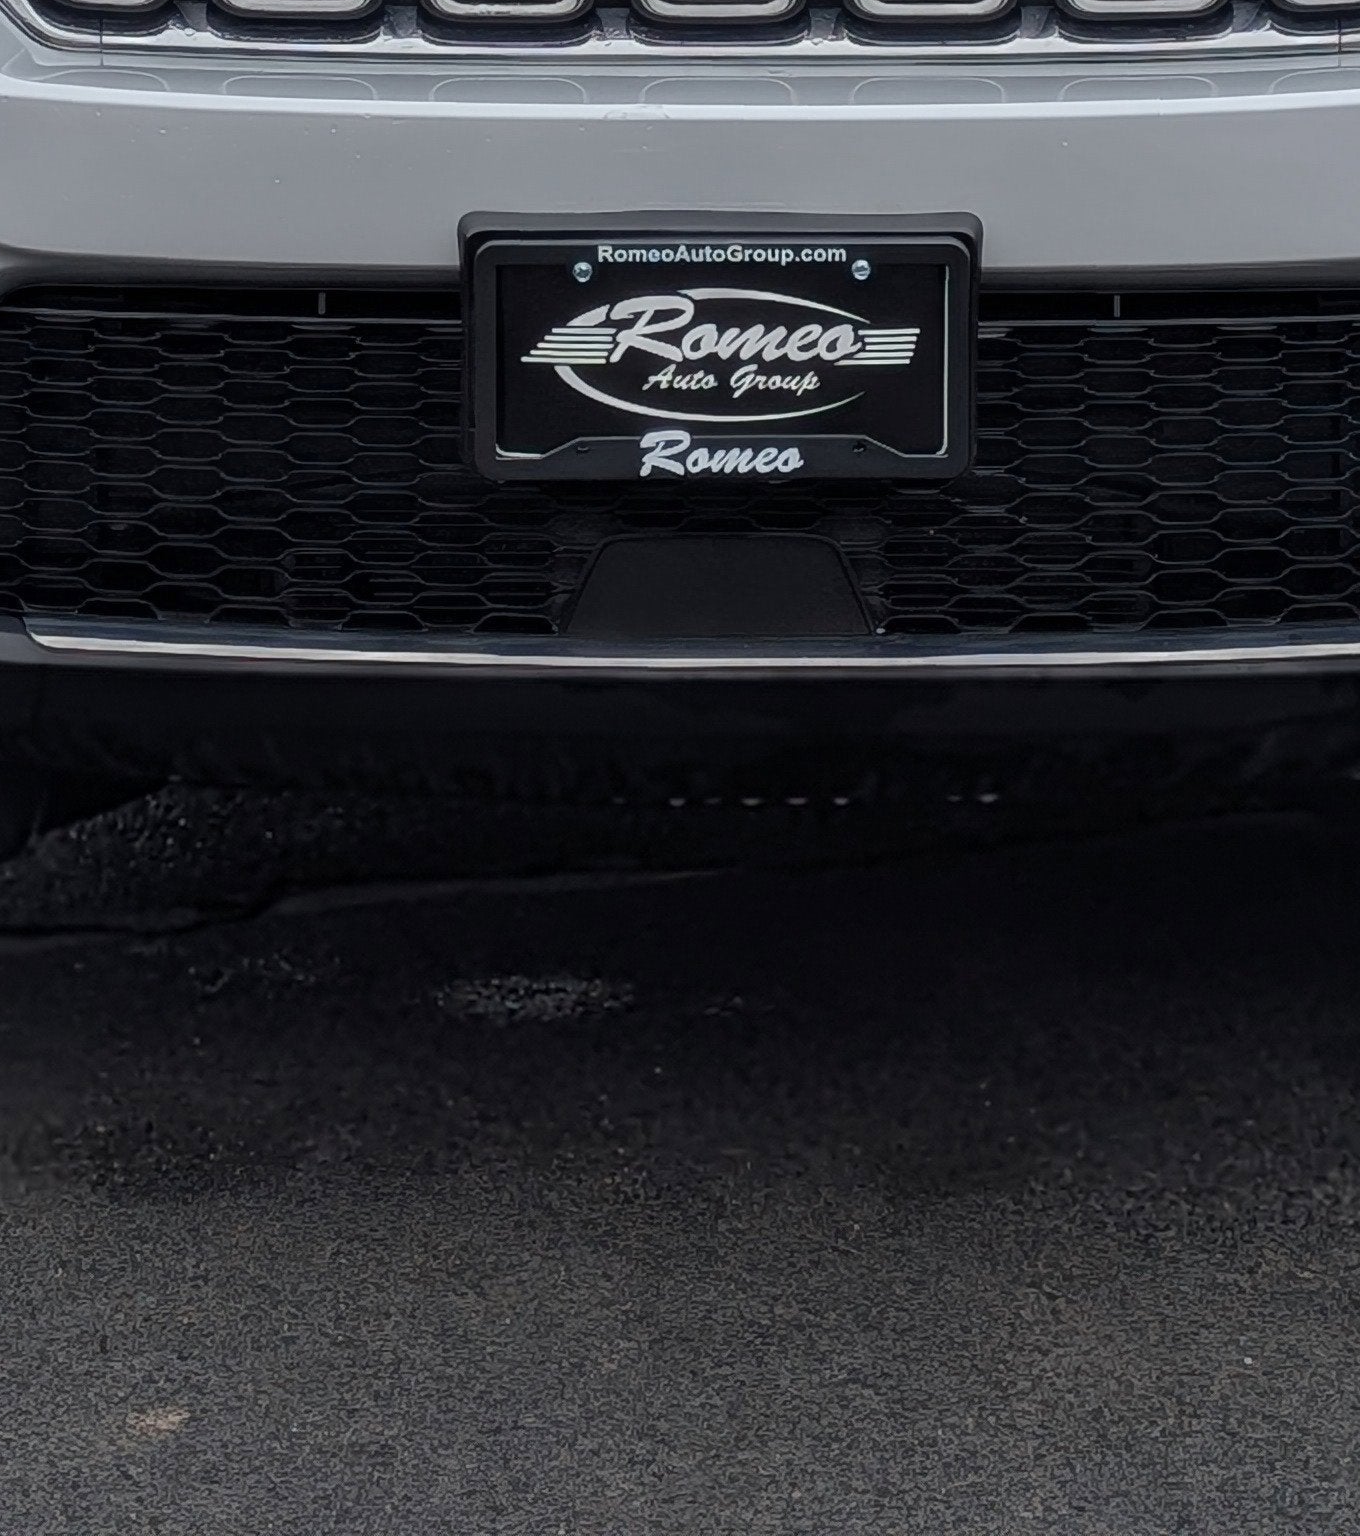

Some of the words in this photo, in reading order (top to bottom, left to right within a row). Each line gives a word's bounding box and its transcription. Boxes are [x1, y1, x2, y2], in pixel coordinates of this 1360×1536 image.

[597, 245, 847, 266] RomeoAutoGroup.com
[608, 295, 862, 363] Romeo
[642, 364, 718, 390] Auto
[730, 364, 820, 398] Group
[639, 430, 804, 478] Romeo
